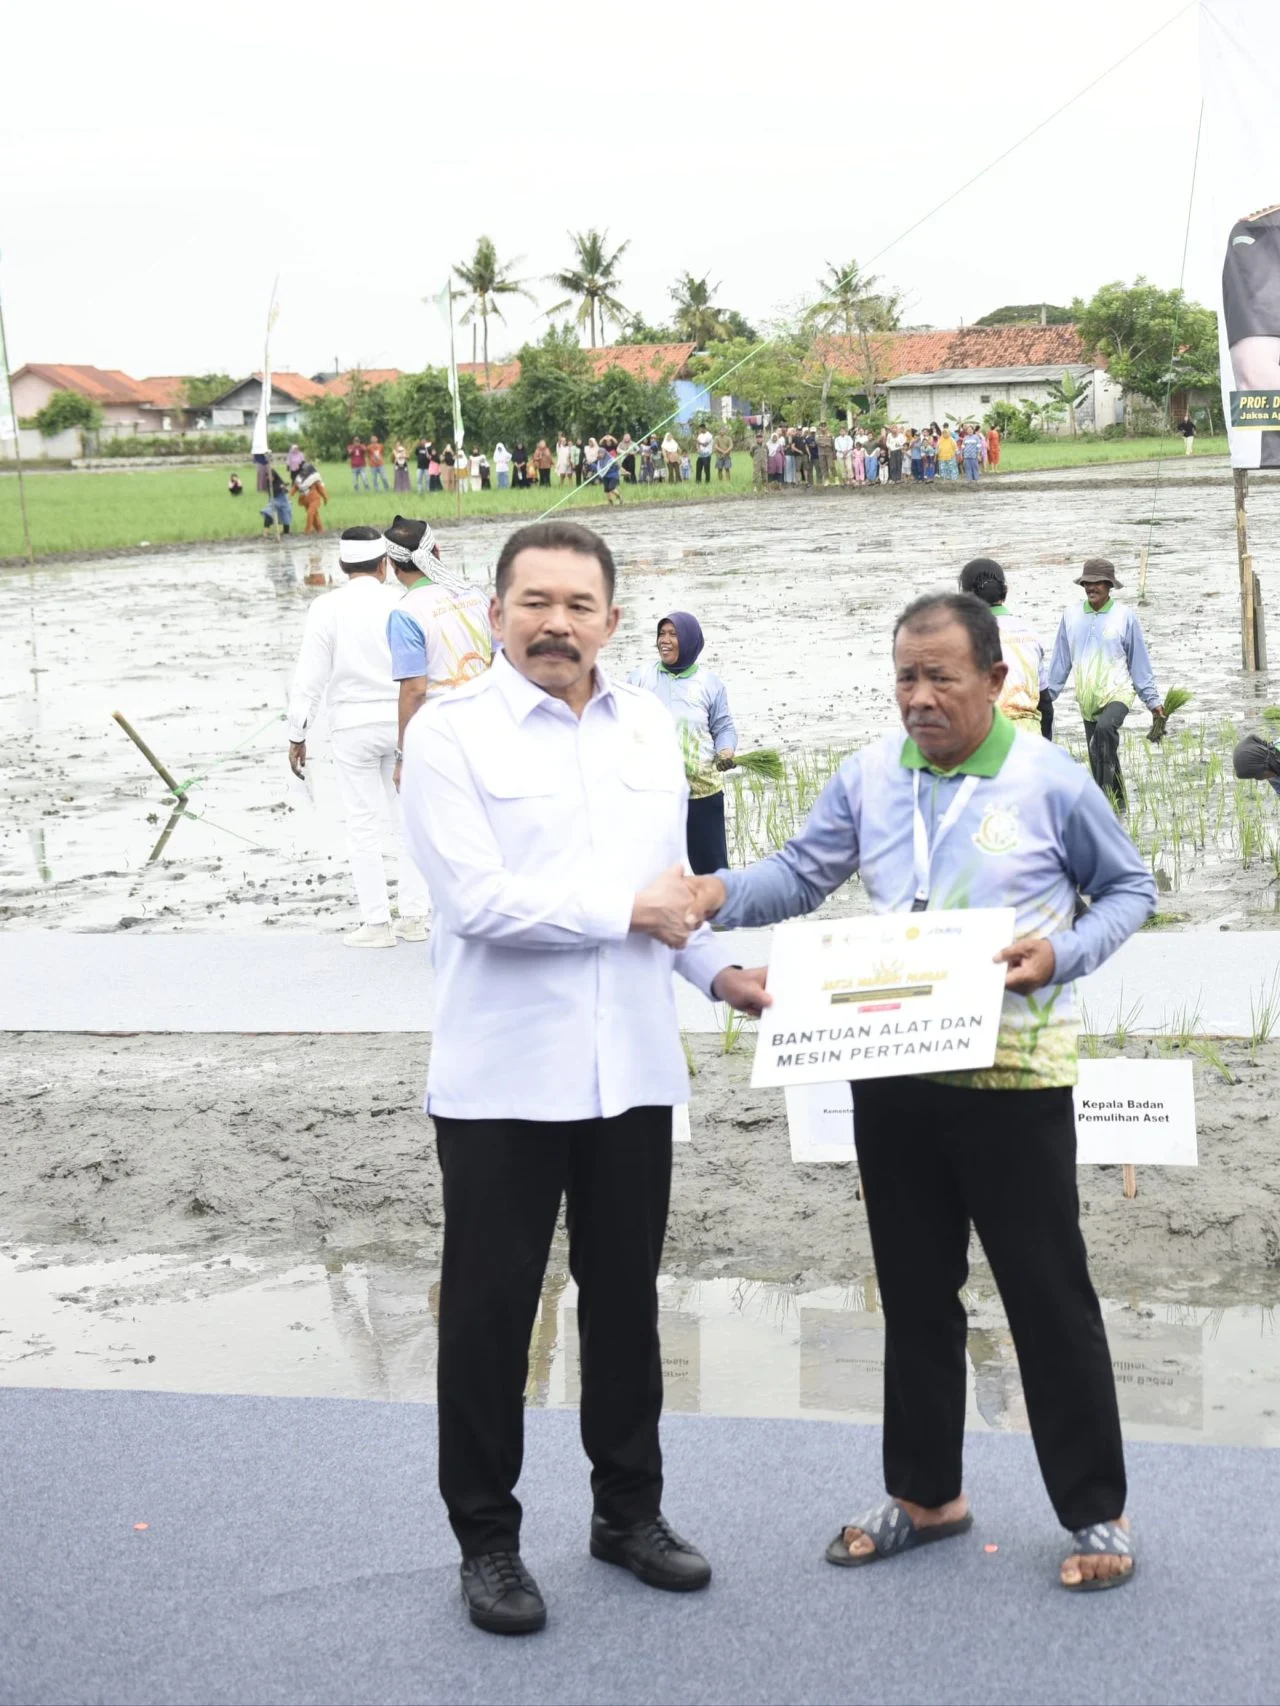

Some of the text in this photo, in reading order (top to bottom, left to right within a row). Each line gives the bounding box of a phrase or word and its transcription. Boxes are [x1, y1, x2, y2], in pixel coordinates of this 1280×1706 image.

[1240, 395, 1269, 409] PROF.
[1240, 411, 1269, 420] Jaksa
[772, 1015, 983, 1047] BANTUAN ALAT DAN
[776, 1037, 971, 1067] MESIN PERTANIAN
[1082, 1099, 1164, 1110] Kepala Badan
[1078, 1113, 1170, 1122] Pemulihan Aset
